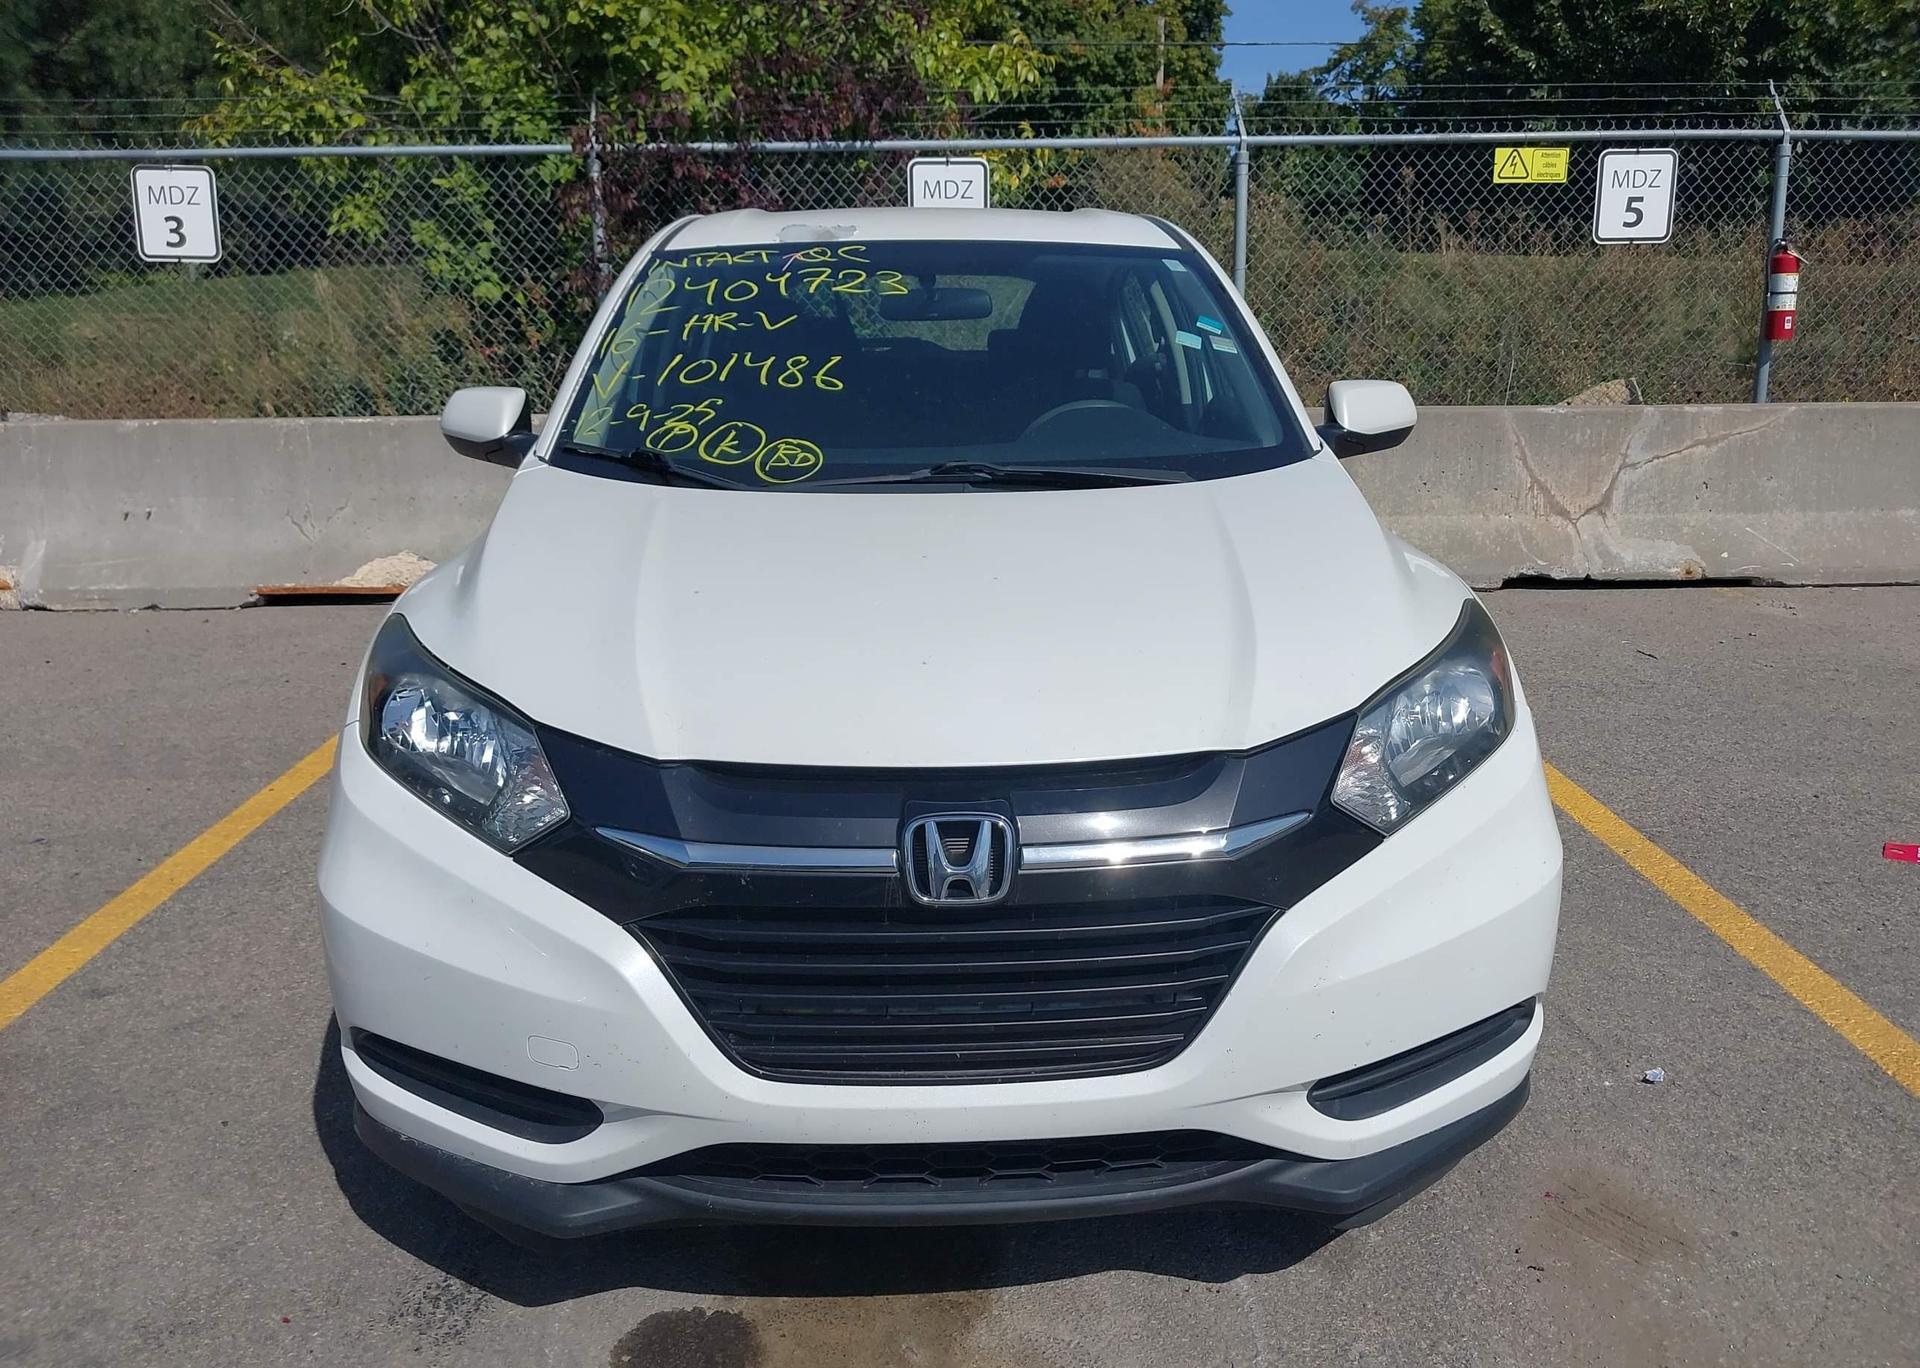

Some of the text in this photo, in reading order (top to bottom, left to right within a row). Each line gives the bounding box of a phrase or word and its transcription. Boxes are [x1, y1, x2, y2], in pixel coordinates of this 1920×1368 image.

[923, 180, 974, 199] MDZ
[1611, 169, 1662, 189] MDZ
[148, 185, 201, 206] MDZ
[1622, 196, 1644, 228] 5
[163, 215, 187, 248] 3
[649, 250, 780, 276] INTACT
